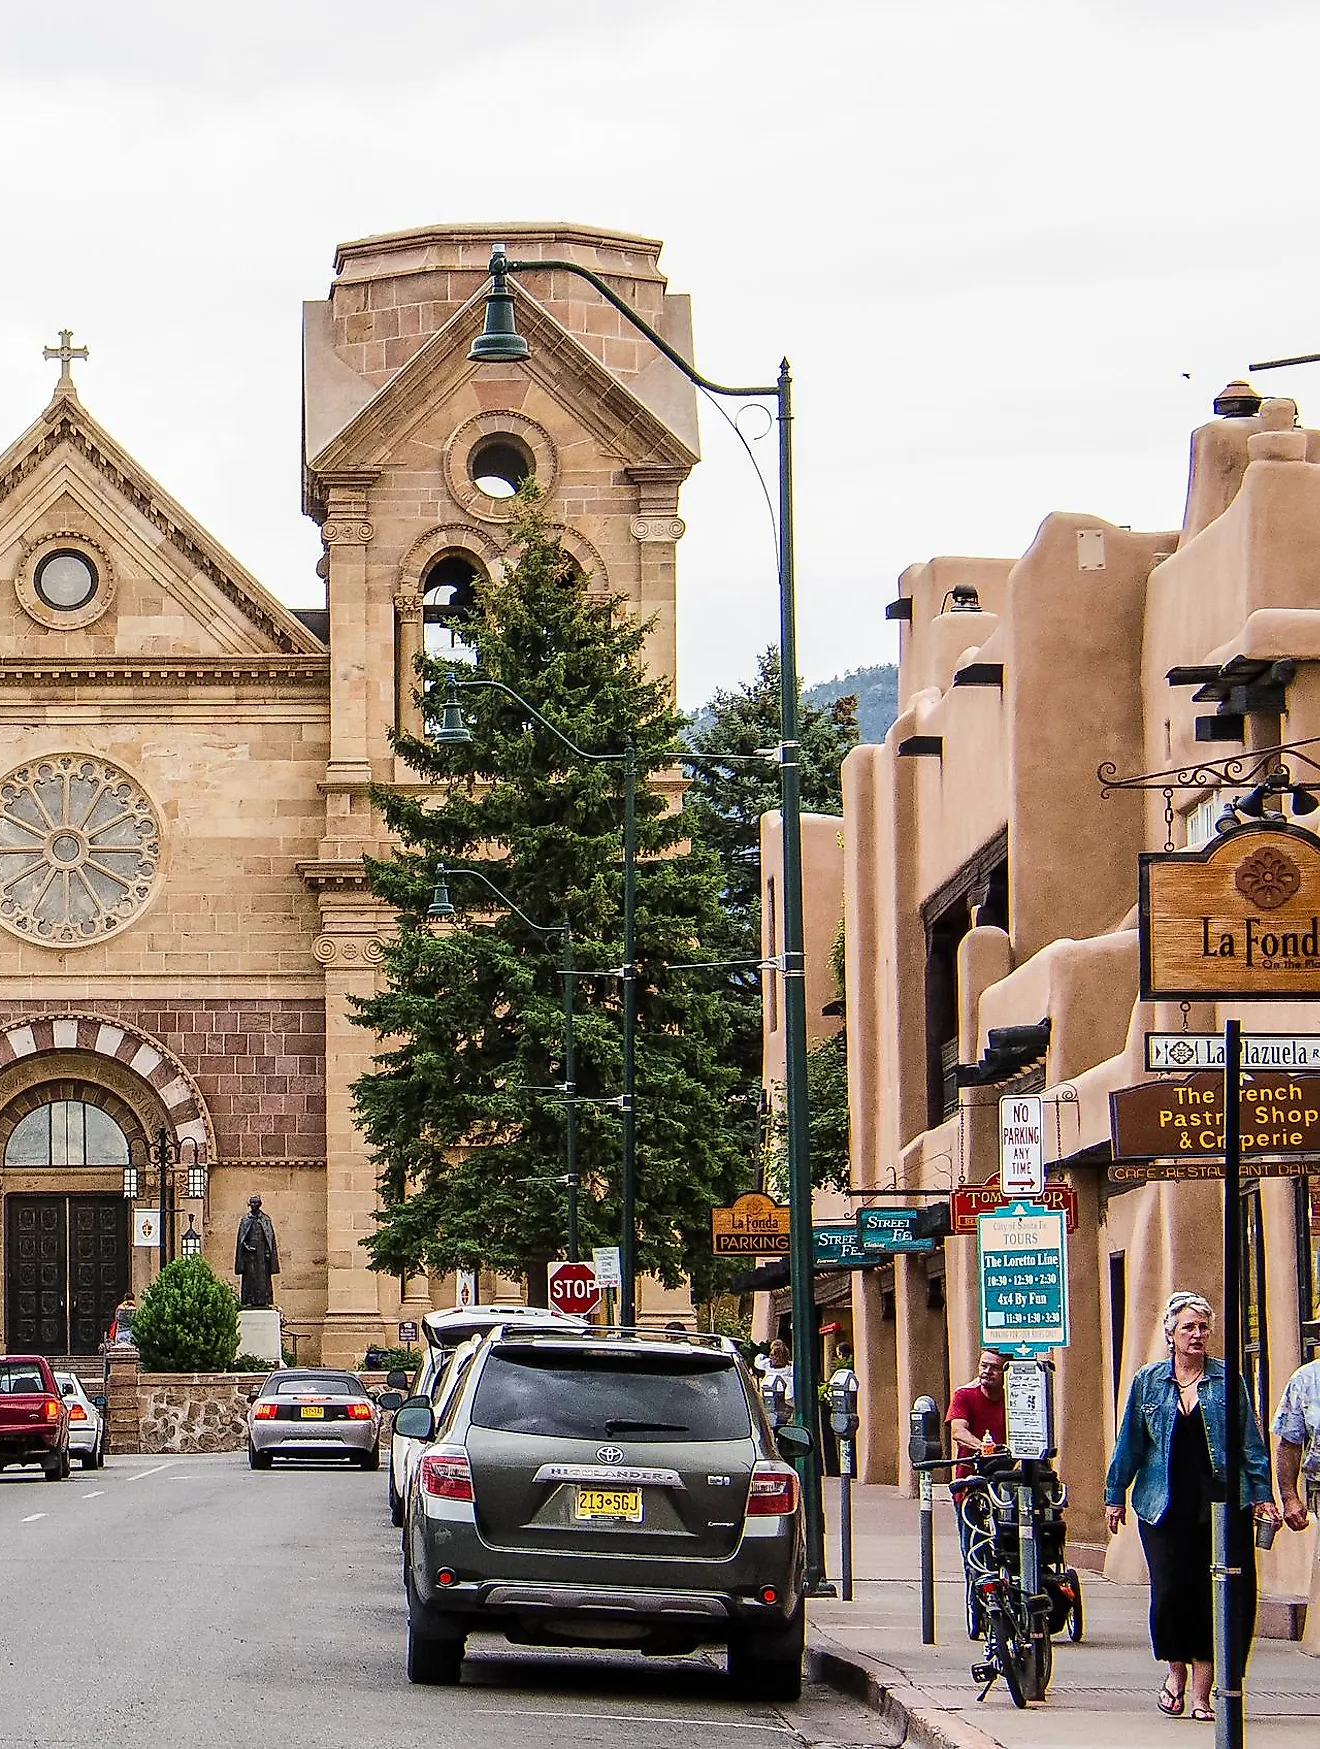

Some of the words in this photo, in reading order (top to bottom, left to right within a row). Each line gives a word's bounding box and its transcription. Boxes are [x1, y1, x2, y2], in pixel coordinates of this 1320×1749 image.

[1200, 917, 1235, 958] La
[1244, 916, 1319, 967] Fond
[1206, 1040, 1225, 1064] La
[1241, 1040, 1308, 1064] lazuela
[1173, 1087, 1215, 1105] The
[1239, 1083, 1302, 1102] rench
[1014, 1105, 1029, 1123] NO
[1159, 1110, 1223, 1127] Pastr
[1255, 1106, 1318, 1127] Shop
[1004, 1127, 1039, 1145] PARKING
[1179, 1131, 1193, 1149] &
[1199, 1128, 1303, 1151] Crperie
[1014, 1147, 1030, 1159] ANY
[1012, 1162, 1032, 1175] TIME
[1165, 1164, 1271, 1178] RESTAUANT
[966, 1191, 1002, 1208] TOM
[731, 1213, 743, 1229] La
[746, 1213, 778, 1232] Fonda
[720, 1236, 788, 1249] PARKING
[818, 1233, 858, 1246] STREE
[1004, 1233, 1038, 1244] TOURS
[985, 1256, 1002, 1268] The
[1003, 1254, 1036, 1267] Loretto
[1037, 1252, 1058, 1266] Line
[987, 1275, 1007, 1287] 10:30
[1014, 1274, 1034, 1286] 12:30
[1040, 1273, 1056, 1284] 2:30
[552, 1280, 596, 1299] STOP
[998, 1293, 1014, 1305] 4x4
[1015, 1293, 1027, 1308] By
[1029, 1292, 1047, 1304] Fun
[1006, 1313, 1022, 1323] 11:30
[1027, 1313, 1040, 1323] 1:30
[1045, 1312, 1060, 1323] 3:30
[551, 1468, 662, 1481] HIGHLANDER
